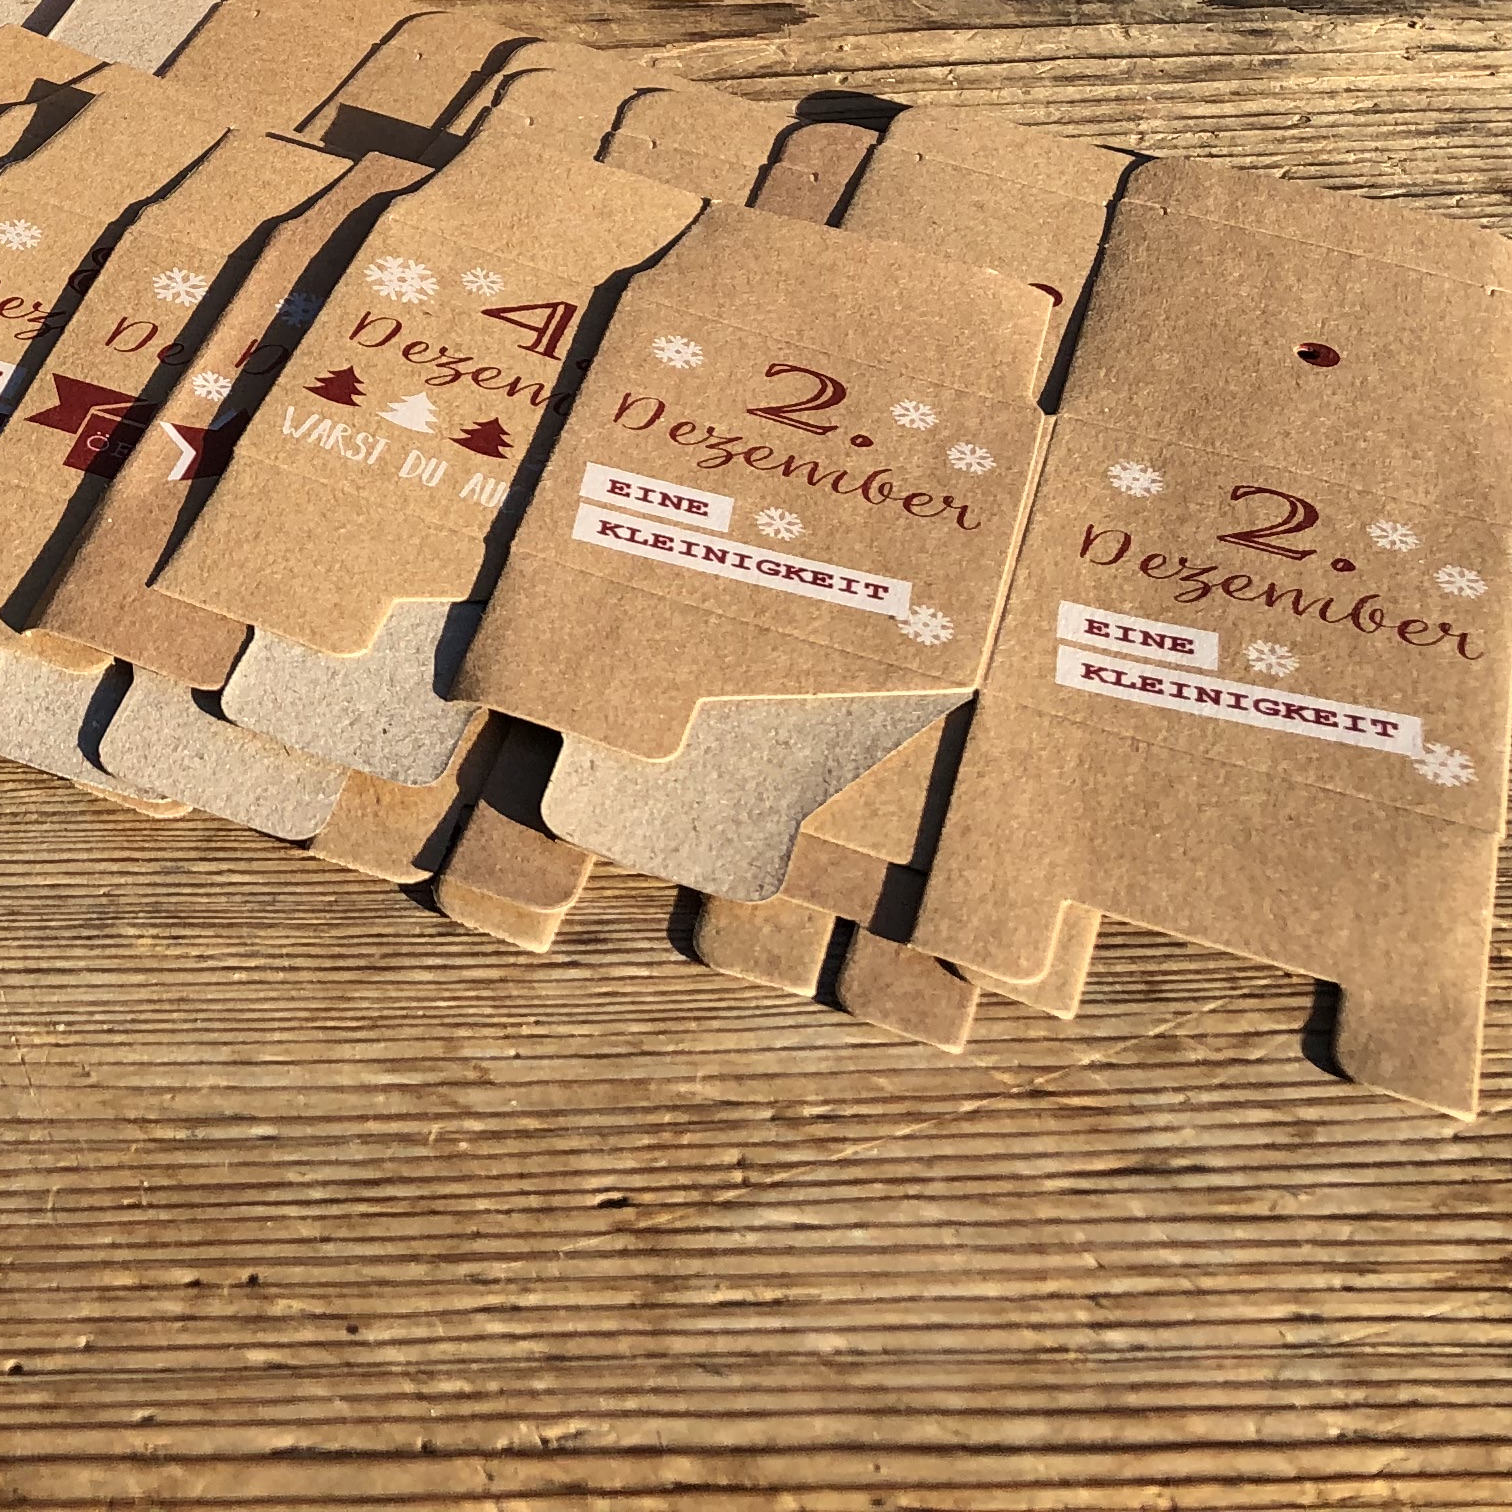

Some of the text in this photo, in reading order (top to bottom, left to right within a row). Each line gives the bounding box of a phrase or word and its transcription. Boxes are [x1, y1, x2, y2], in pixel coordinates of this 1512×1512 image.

[283, 405, 391, 465] WARST
[398, 449, 449, 488] DU
[746, 362, 875, 448] 2.
[606, 478, 710, 518] EINE
[613, 391, 982, 531] Dezember
[596, 519, 890, 601] KLEINIGKEIT
[1216, 484, 1357, 572] 2.
[1079, 523, 1485, 660] Dezember
[1084, 618, 1195, 655] EINE
[1080, 662, 1399, 738] KLEINIGKEIT
